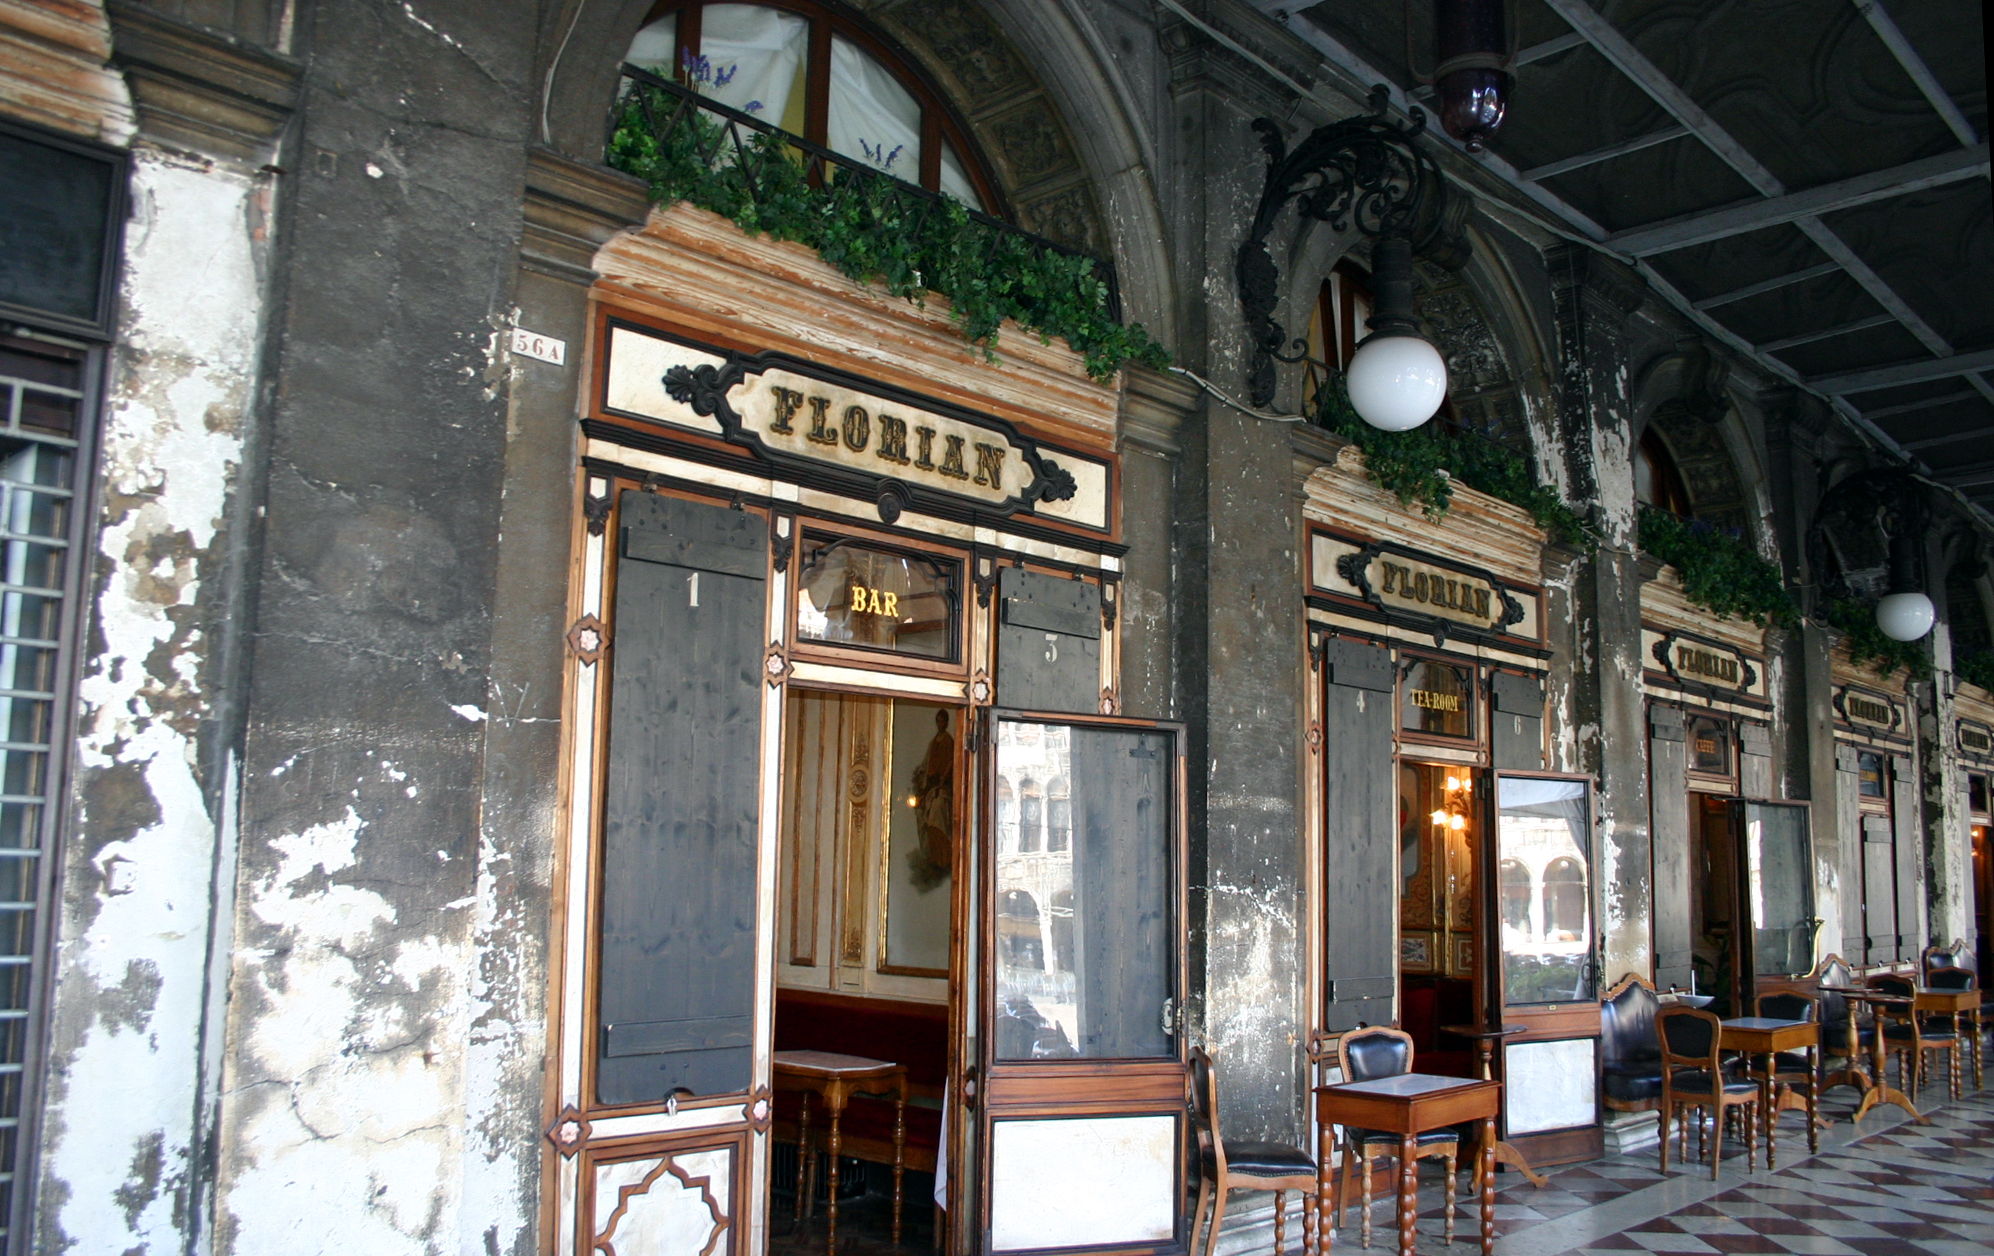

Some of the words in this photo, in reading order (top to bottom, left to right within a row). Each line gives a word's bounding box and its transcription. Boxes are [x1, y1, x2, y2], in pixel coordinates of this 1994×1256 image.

[769, 386, 1006, 490] FLORIAN
[686, 572, 699, 607] 1
[851, 586, 898, 618] BAR
[1382, 561, 1491, 619] FLORIAN
[1045, 633, 1058, 662] 3
[1356, 690, 1366, 713] 4
[1410, 688, 1459, 712] TEA-ROOM
[1514, 715, 1521, 735] 6
